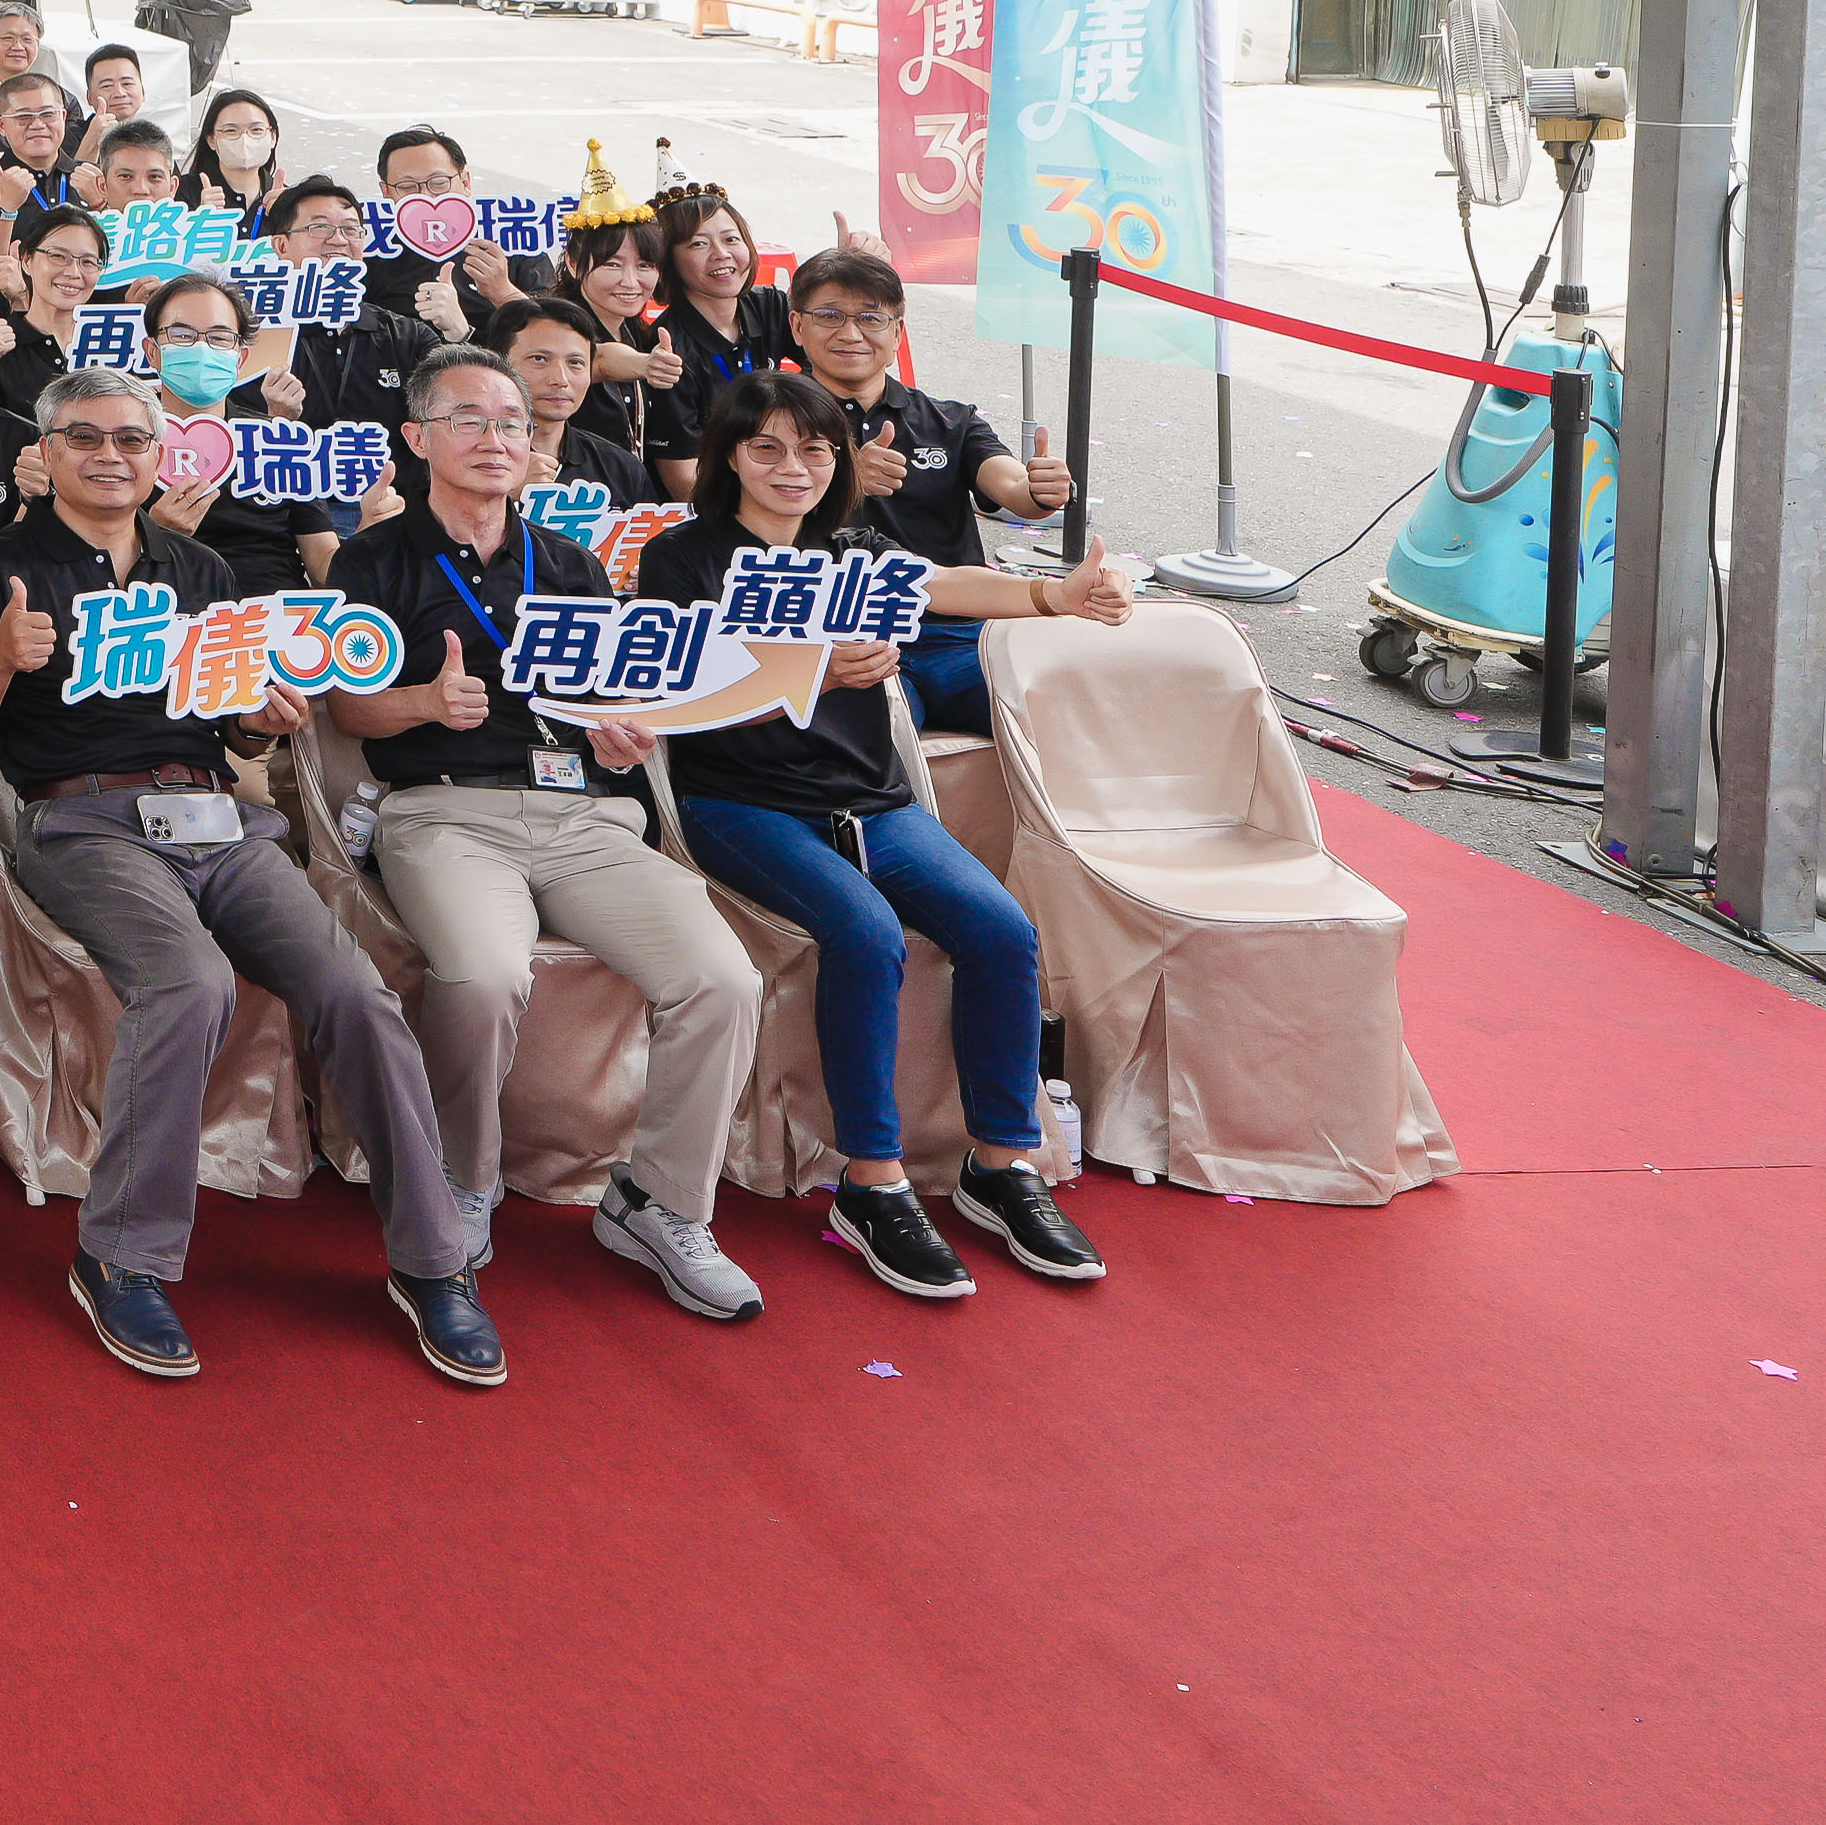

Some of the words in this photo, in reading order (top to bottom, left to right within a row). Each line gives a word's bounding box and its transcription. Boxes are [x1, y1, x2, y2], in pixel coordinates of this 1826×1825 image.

[1007, 164, 1179, 280] 30
[71, 262, 363, 376] 再巔峰
[234, 422, 386, 497] 瑞儀
[911, 446, 948, 471] 30
[68, 586, 399, 717] 瑞儀30
[508, 549, 930, 694] 再創巔峰
